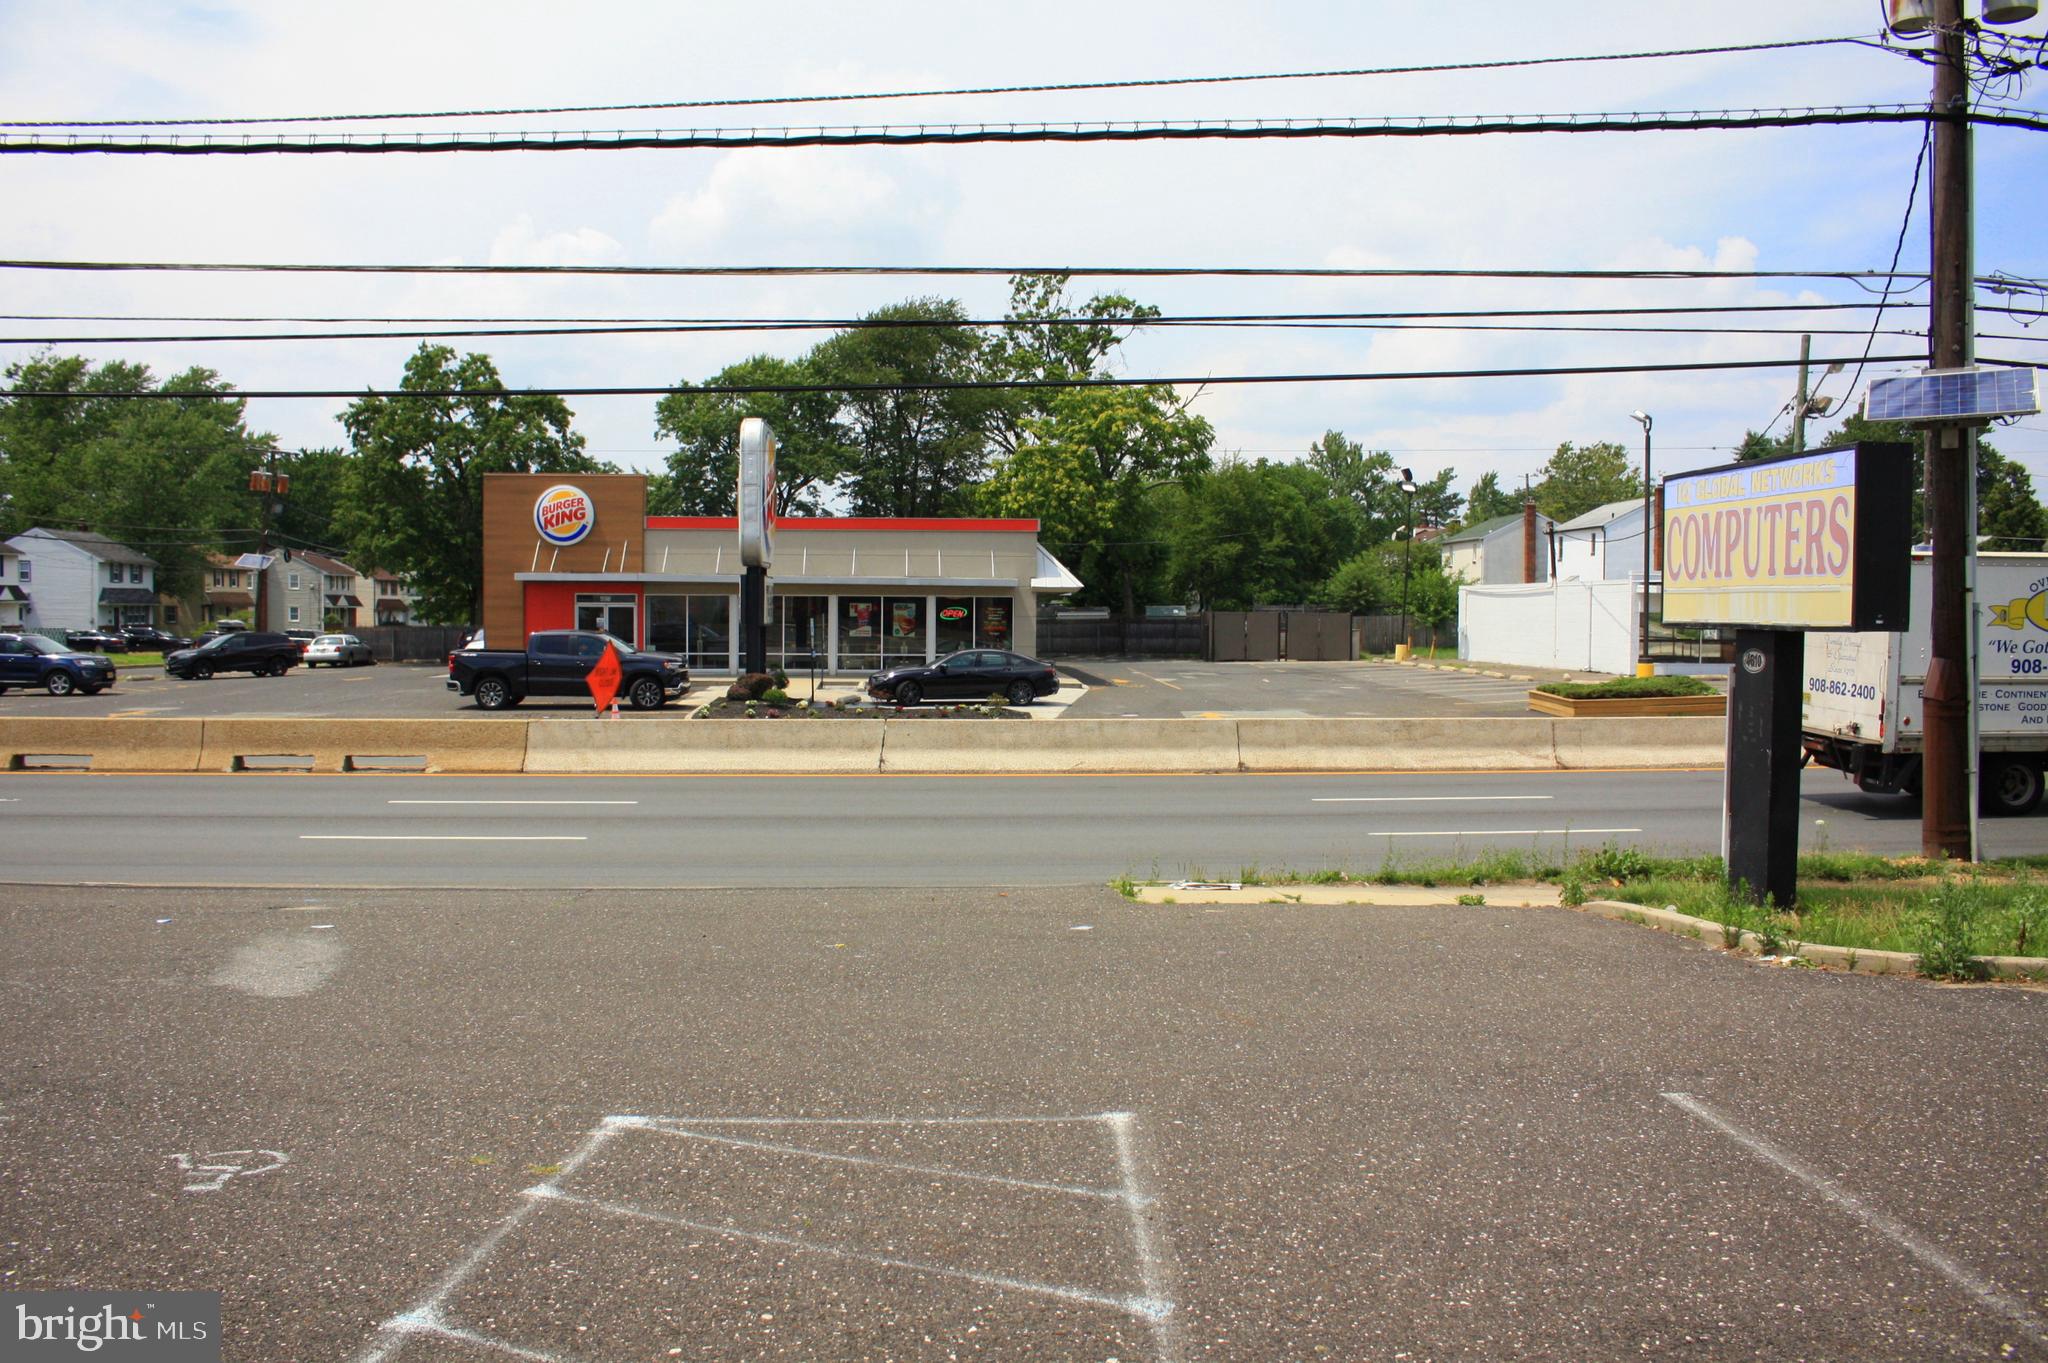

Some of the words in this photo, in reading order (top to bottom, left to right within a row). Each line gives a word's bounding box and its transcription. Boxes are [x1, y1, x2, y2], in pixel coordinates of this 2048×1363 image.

[1677, 483, 1692, 504] IQ
[1696, 474, 1745, 499] GLOBAL
[1751, 458, 1836, 493] NETWORKS
[541, 497, 585, 517] BURGER
[543, 507, 586, 531] KING
[1666, 495, 1850, 582] COMPUTERS
[942, 609, 965, 619] OPEN
[1809, 677, 1875, 700] 908-862-2400
